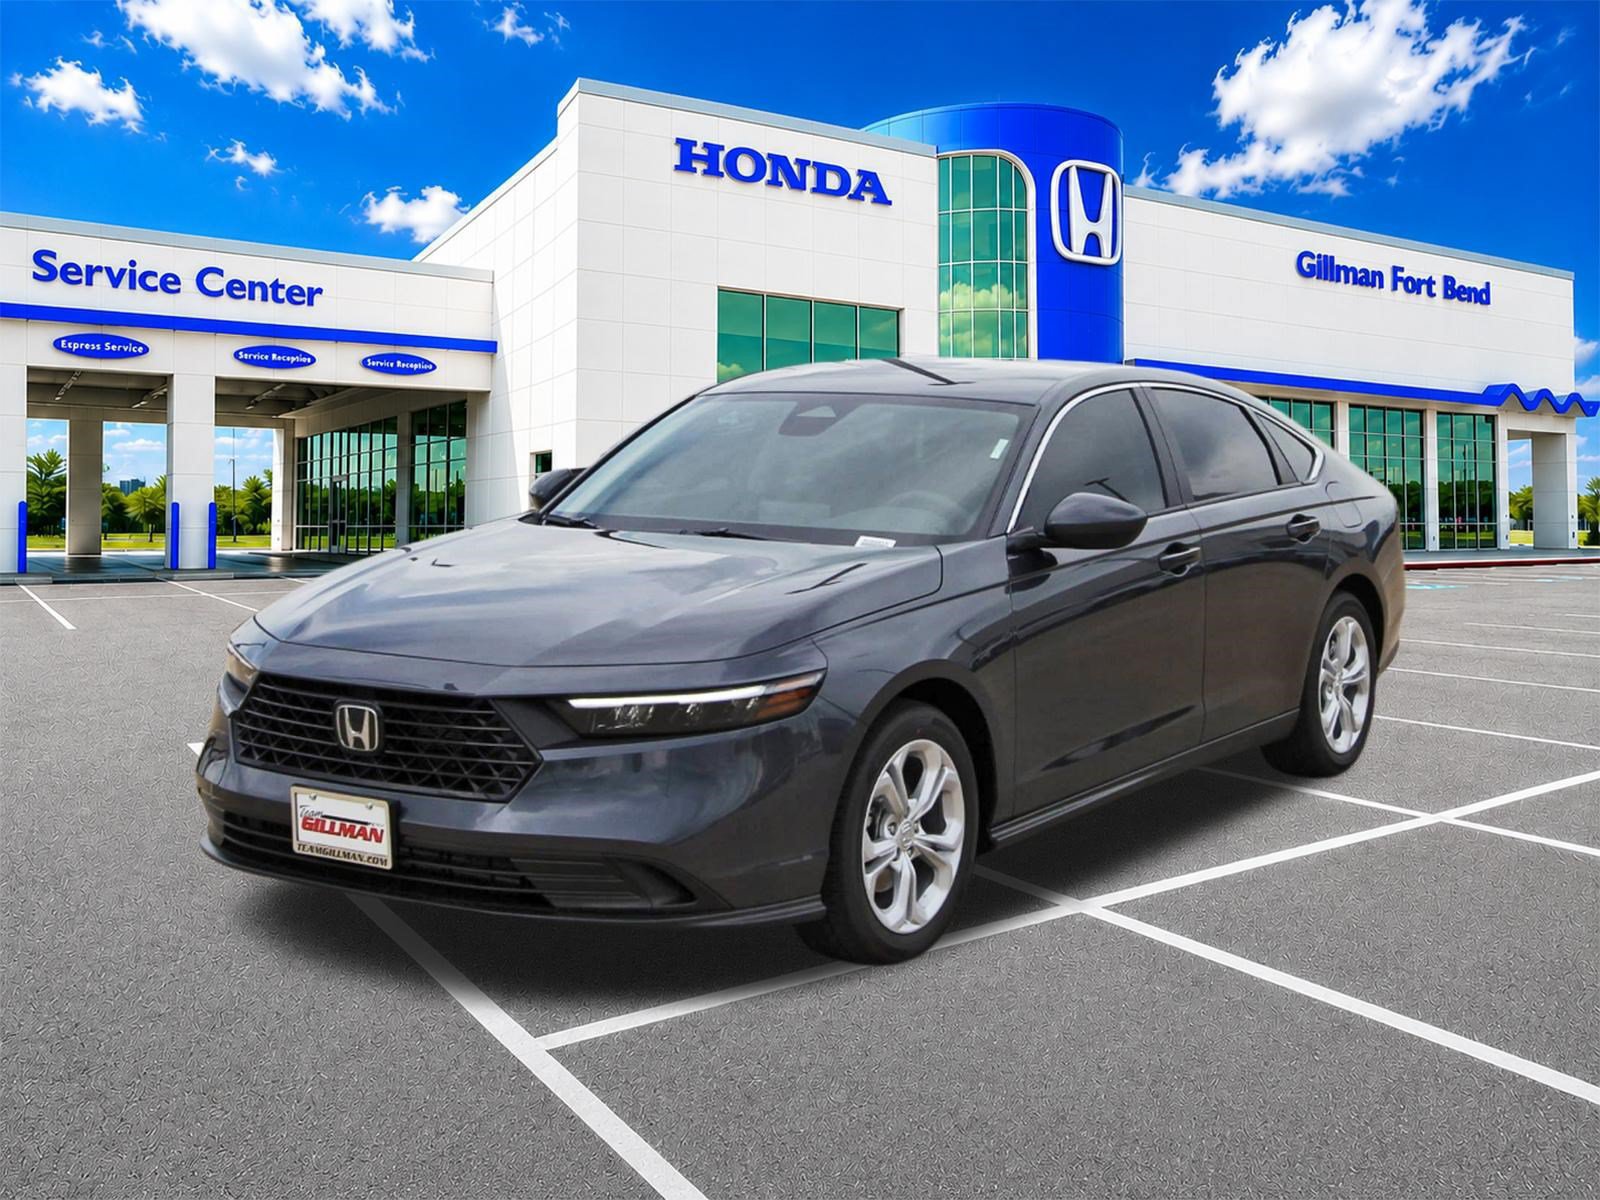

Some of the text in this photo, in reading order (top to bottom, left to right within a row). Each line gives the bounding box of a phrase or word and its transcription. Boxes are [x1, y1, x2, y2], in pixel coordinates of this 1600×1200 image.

[674, 137, 892, 206] HONDA
[32, 249, 324, 307] Service Center
[1296, 250, 1491, 305] Gillman Fort Bend
[104, 342, 144, 354] Service
[238, 351, 270, 361] Service
[366, 358, 395, 368] Service
[299, 804, 323, 818] Team
[301, 815, 385, 844] GILLMAN
[296, 843, 388, 867] TEAMGILLMAN.COM
